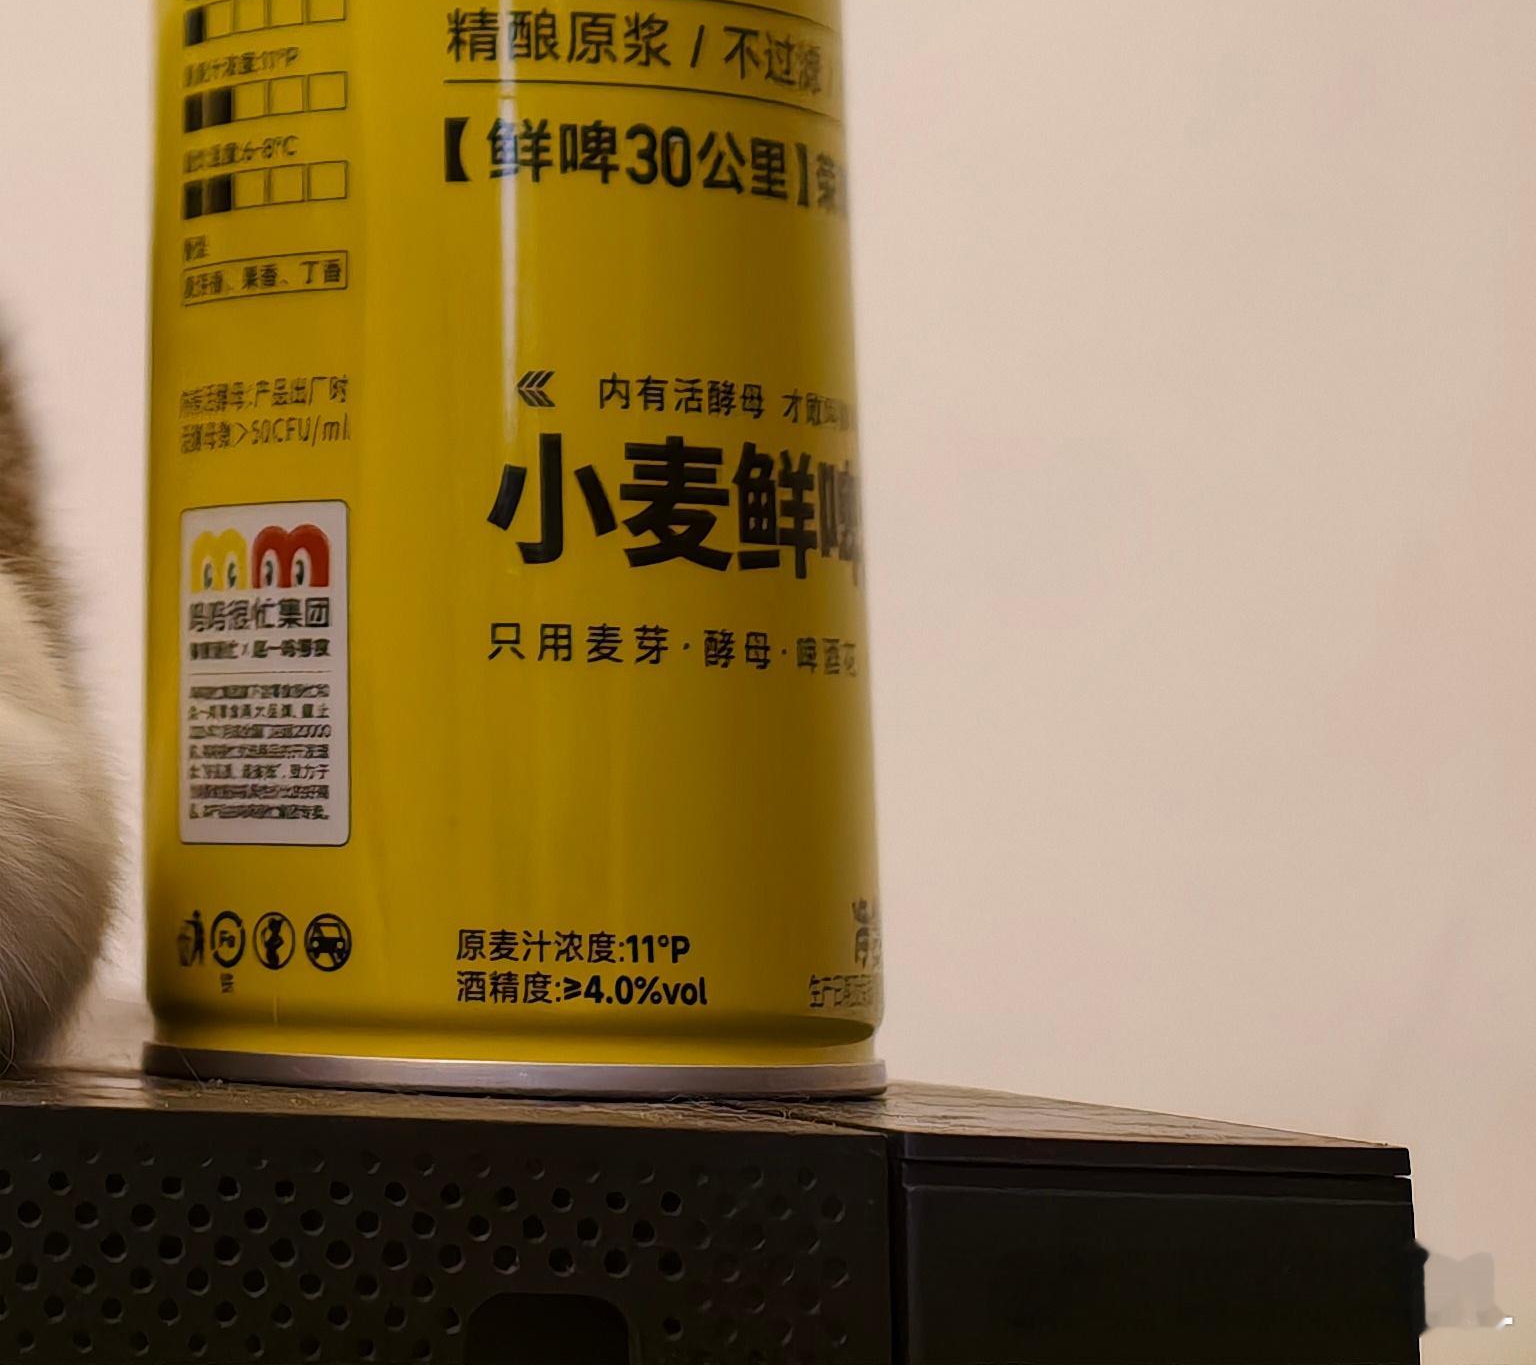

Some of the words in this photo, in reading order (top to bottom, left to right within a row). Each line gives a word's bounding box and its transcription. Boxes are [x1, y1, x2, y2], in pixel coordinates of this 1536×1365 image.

[447, 8, 671, 67] 精酿原浆
[599, 372, 765, 419] 内有活酵母
[456, 929, 691, 964] 原麦汁浓度:11°P
[456, 970, 708, 1006] 酒精度:≥4.0%vol
